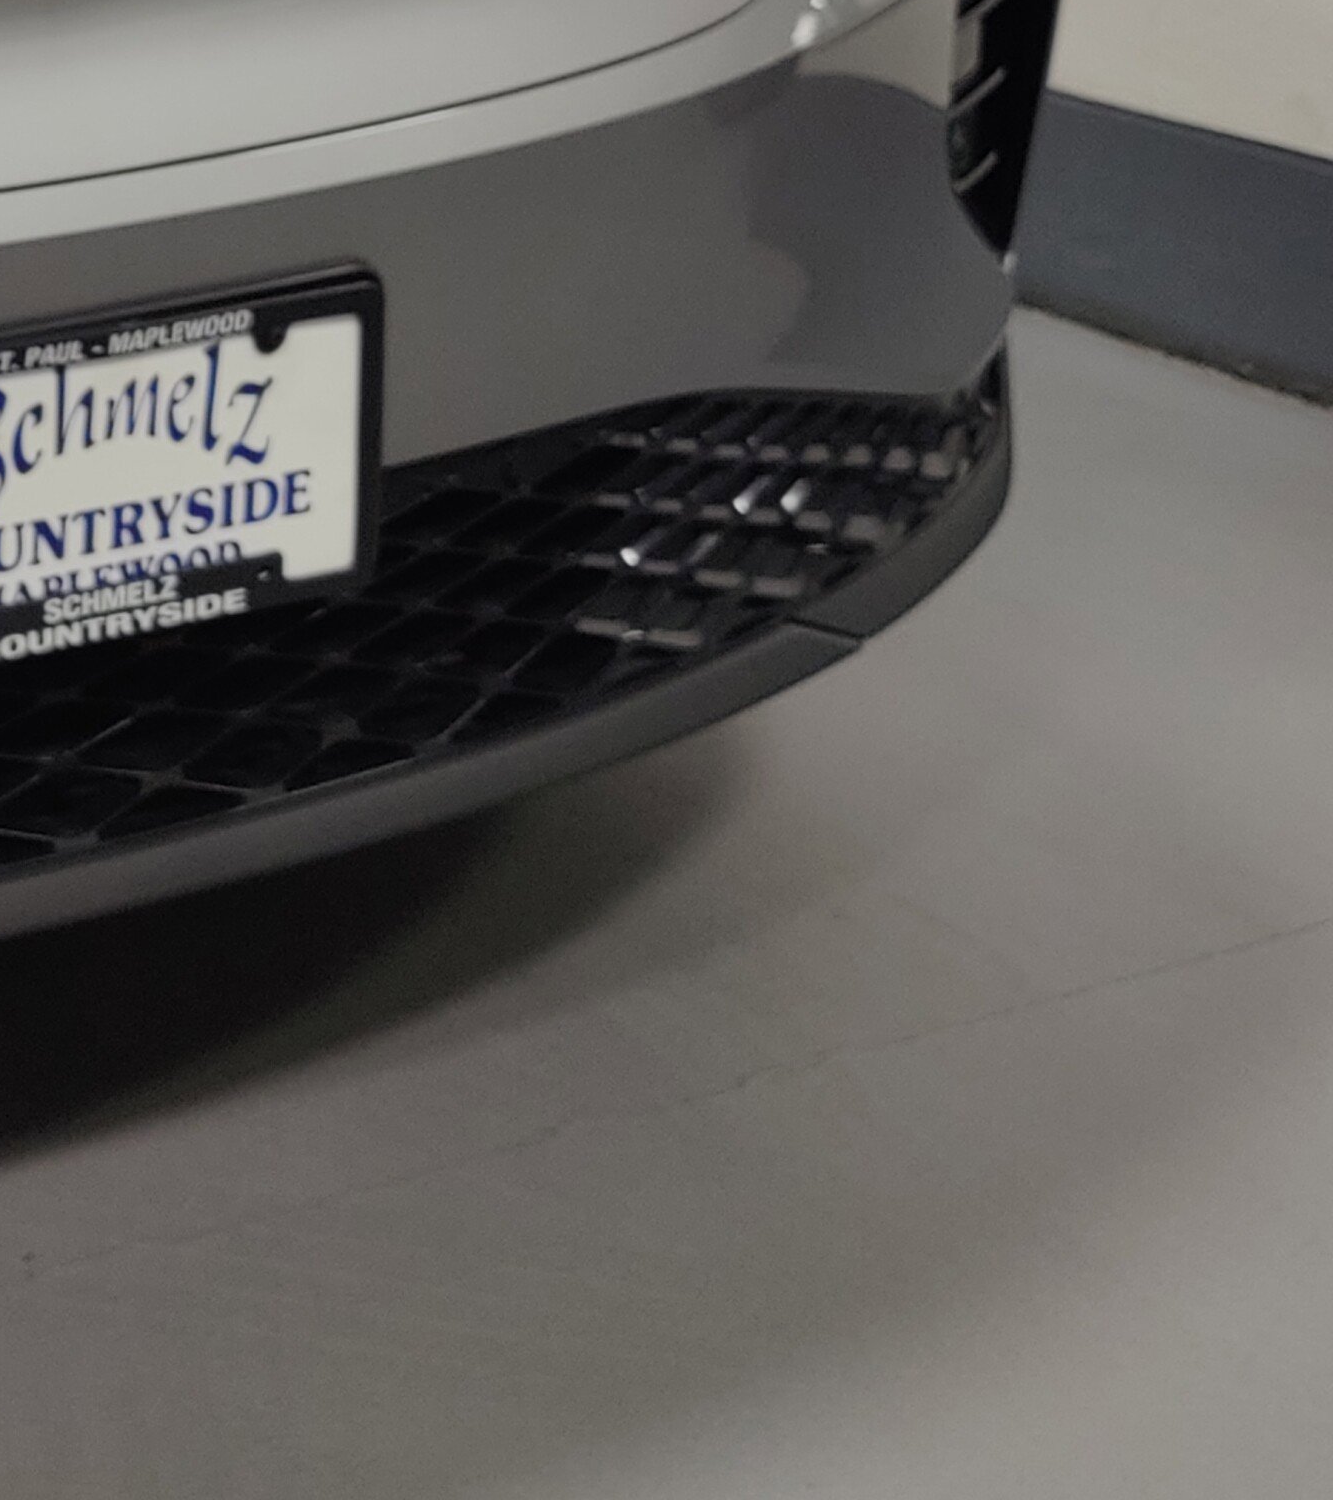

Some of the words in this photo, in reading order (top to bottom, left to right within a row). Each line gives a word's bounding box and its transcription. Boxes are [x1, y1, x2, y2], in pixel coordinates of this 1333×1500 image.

[24, 341, 83, 367] PAUL
[108, 308, 253, 354] MAPLEWOOD
[43, 574, 180, 625] SCHMELZ
